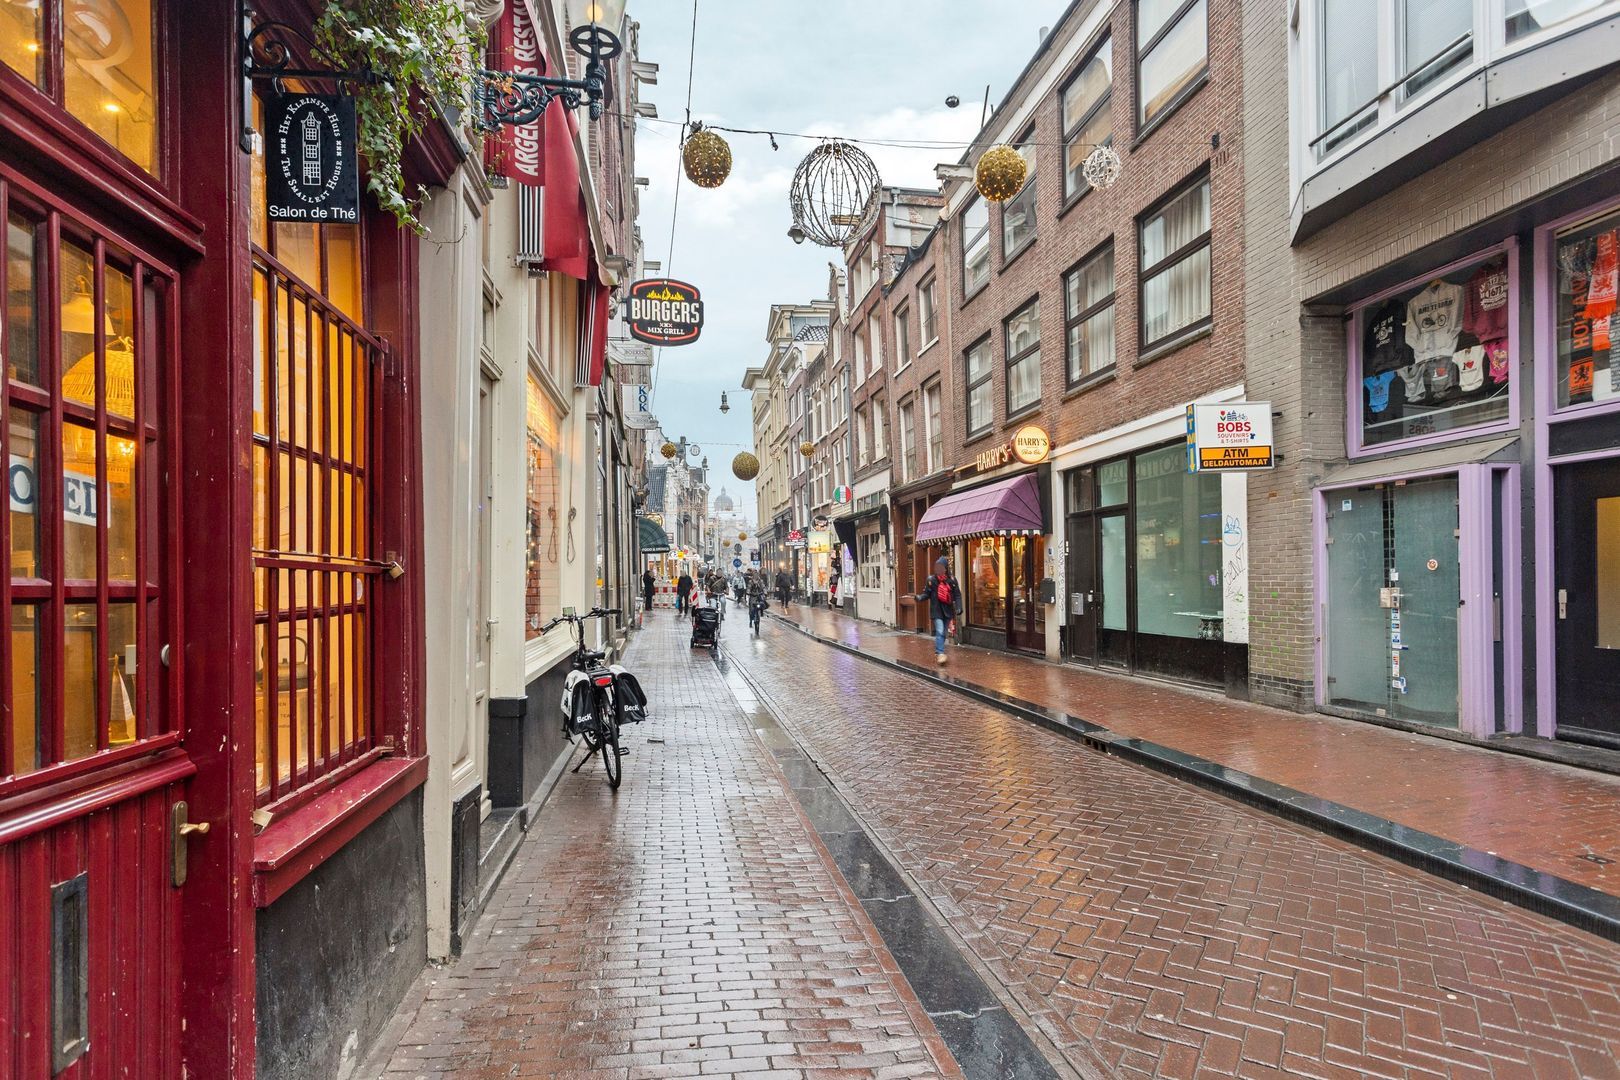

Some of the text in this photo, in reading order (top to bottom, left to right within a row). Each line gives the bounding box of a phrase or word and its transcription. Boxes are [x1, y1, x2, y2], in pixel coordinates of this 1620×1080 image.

[279, 97, 341, 137] HET KLEINSTE HUIS
[514, 65, 539, 177] ARGES
[281, 157, 342, 203] THE SMALLEST HOUSE
[269, 205, 356, 219] Salon de Thé
[631, 298, 700, 324] BURGERS
[638, 385, 647, 412] KOK
[1187, 405, 1196, 444] ATM
[1217, 421, 1251, 432] BOBS
[1017, 437, 1048, 446] HARRY'S
[1223, 448, 1249, 458] ATM
[976, 443, 1008, 472] HARRY'S
[1203, 459, 1268, 467] GELDAUTOMAAT
